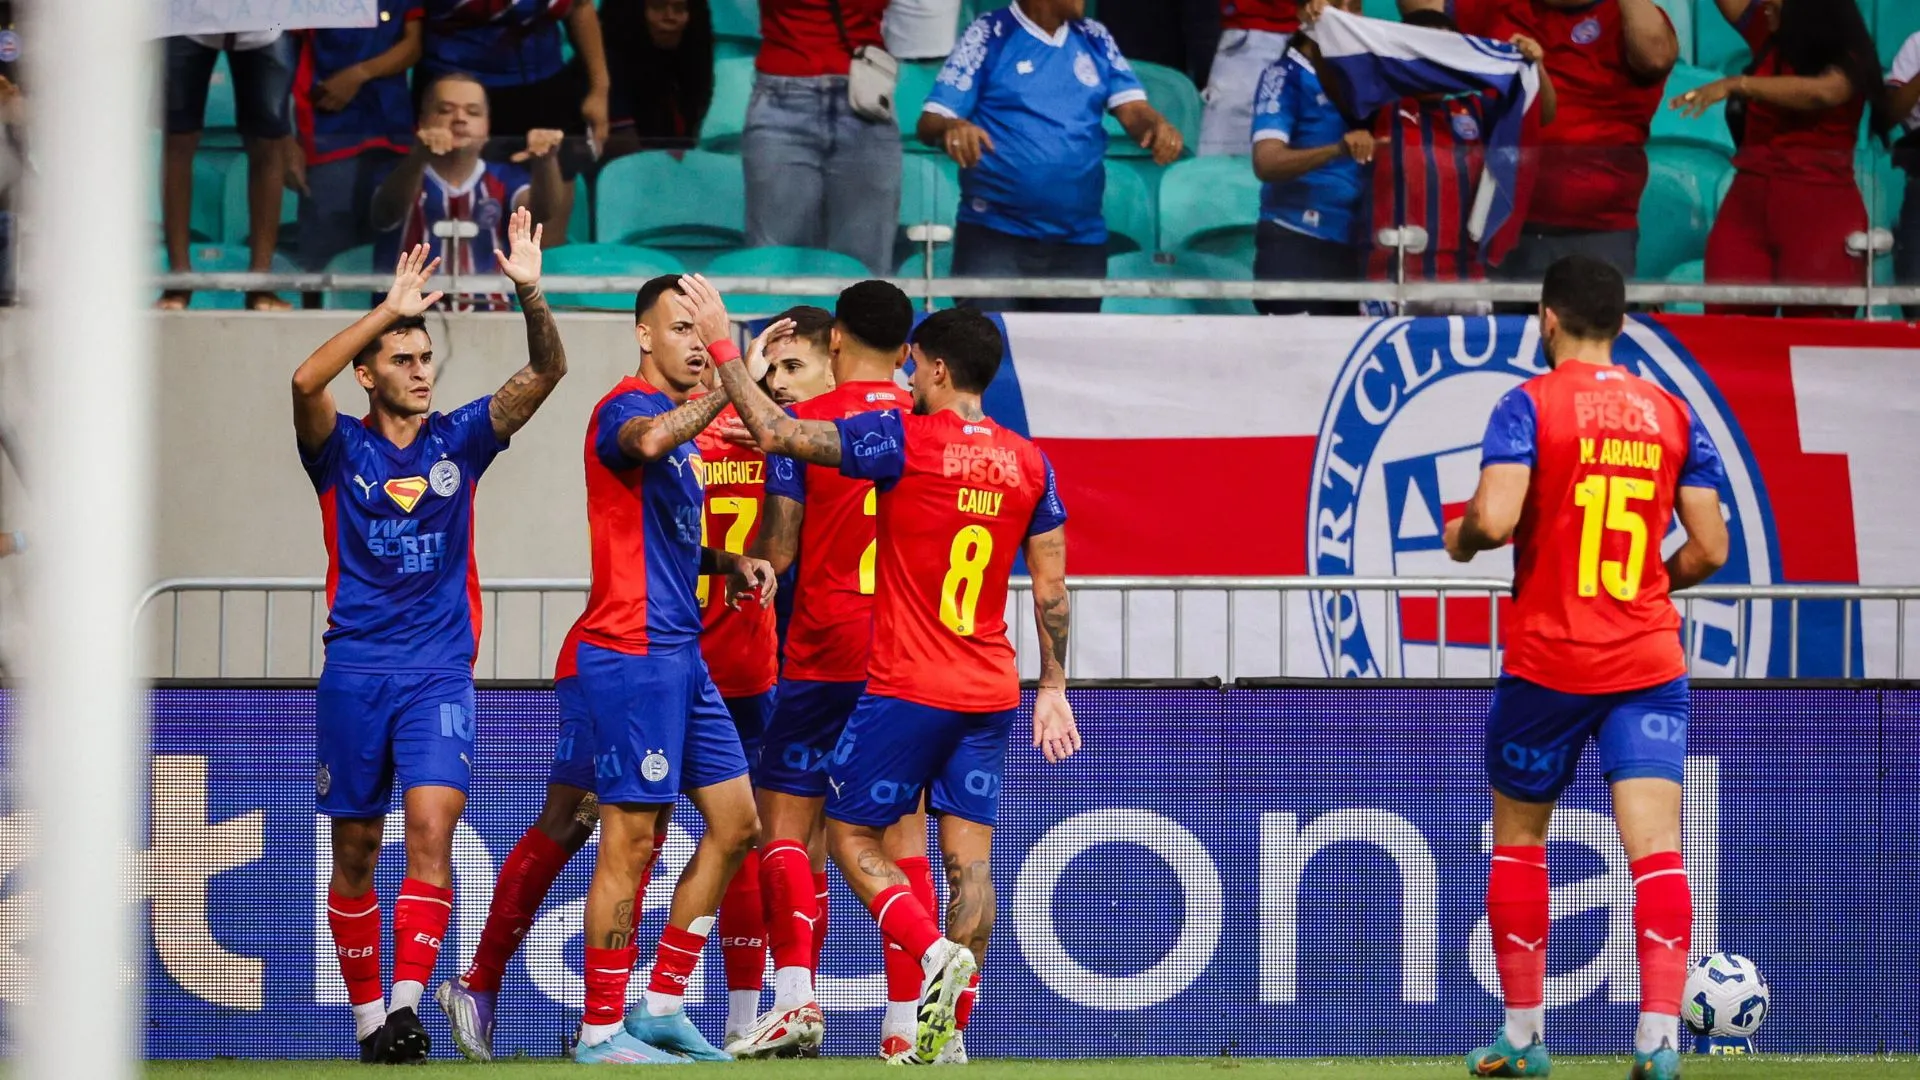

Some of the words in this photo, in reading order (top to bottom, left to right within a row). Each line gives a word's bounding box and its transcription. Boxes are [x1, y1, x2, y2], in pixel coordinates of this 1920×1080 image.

[1576, 404, 1660, 435] PISOS
[1580, 438, 1597, 464] M.
[1600, 438, 1662, 471] ARAUJO
[943, 458, 1020, 488] PISOS
[957, 487, 1003, 516] CAULY
[367, 532, 448, 557] SORTE
[1575, 475, 1655, 601] 15
[939, 525, 993, 636] 8
[338, 945, 374, 958] ECB
[721, 936, 763, 948] ECB
